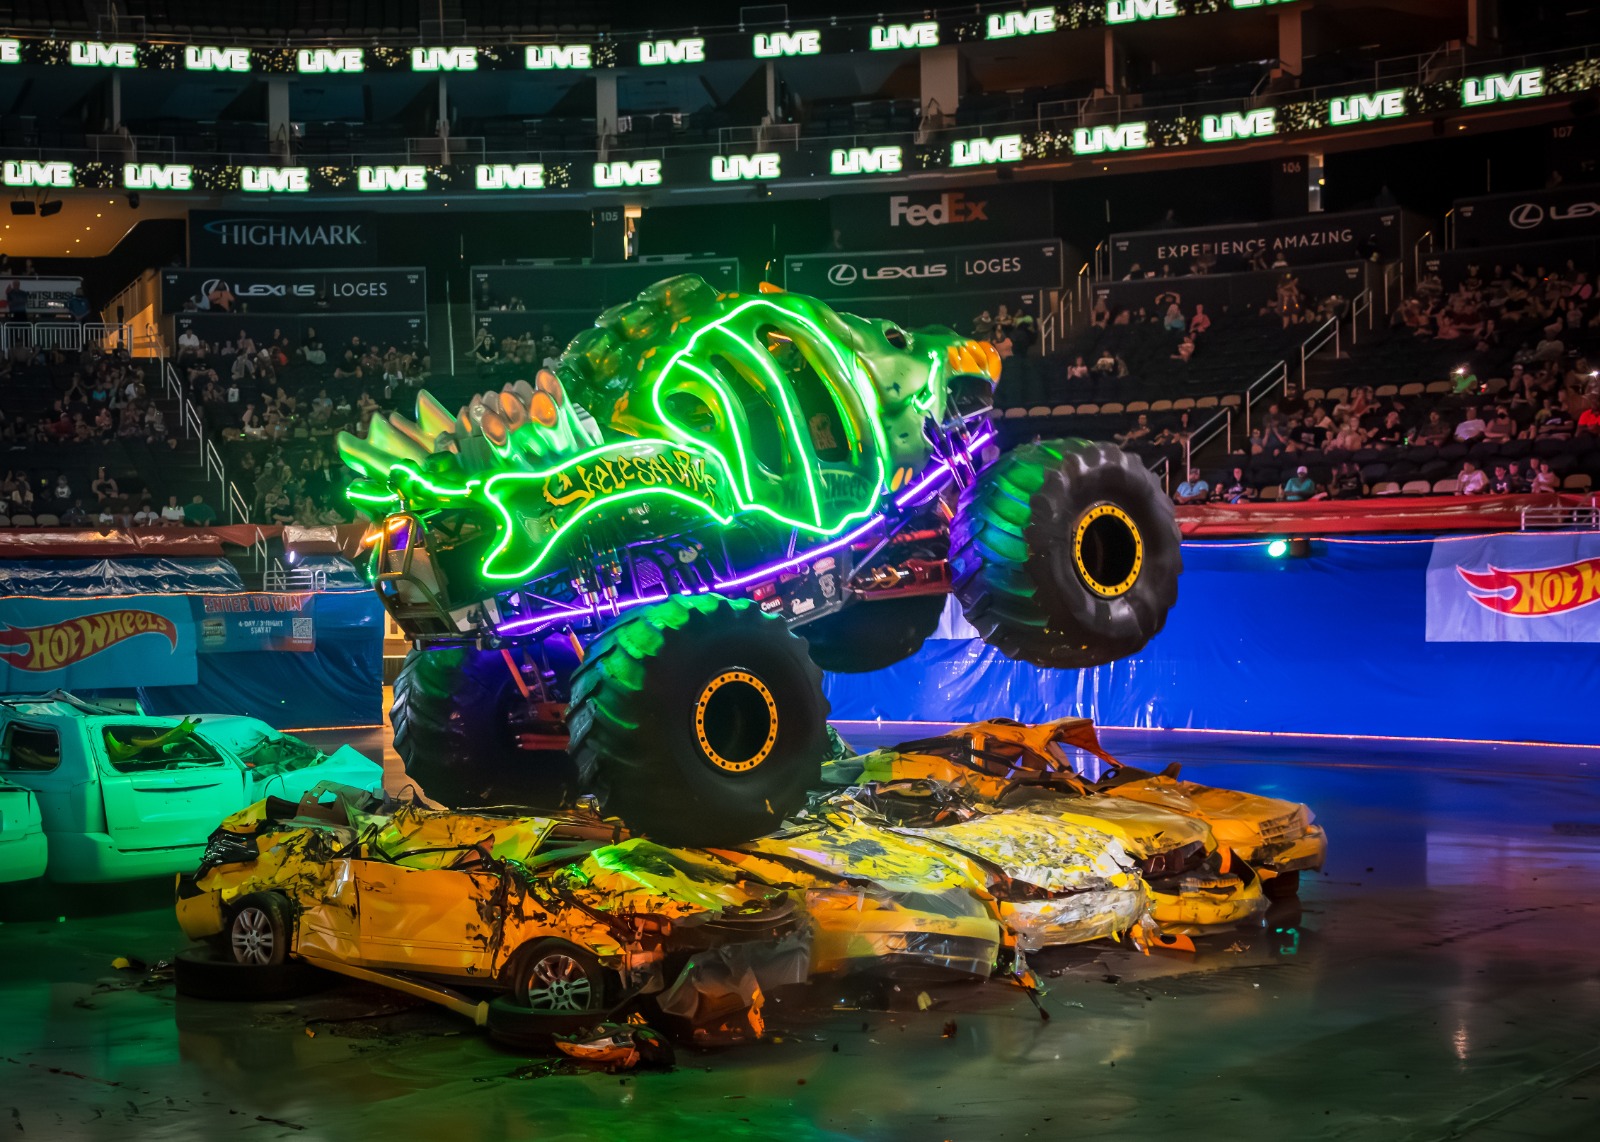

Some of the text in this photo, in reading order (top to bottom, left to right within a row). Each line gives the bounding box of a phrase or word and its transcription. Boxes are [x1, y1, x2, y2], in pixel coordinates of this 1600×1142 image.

[988, 8, 1056, 38] LIVE
[1108, 0, 1177, 22] LIVE
[754, 31, 820, 57] LIVE
[871, 22, 938, 49] LIVE
[71, 42, 136, 66] LIVE
[186, 46, 250, 71] LIVE
[298, 48, 363, 72] LIVE
[412, 47, 476, 70] LIVE
[526, 45, 591, 69] LIVE
[639, 38, 704, 64] LIVE
[1465, 71, 1542, 103] LIVE
[1331, 91, 1404, 123] LIVE
[1074, 123, 1146, 153] LIVE
[1203, 110, 1275, 141] LIVE
[1553, 126, 1574, 138] 107
[832, 147, 901, 174] LIVE
[953, 135, 1023, 166] LIVE
[4, 161, 72, 186] LIVE
[124, 164, 192, 189] LIVE
[242, 167, 308, 191] LIVE
[359, 166, 425, 190] LIVE
[476, 164, 542, 189] LIVE
[594, 160, 661, 187] LIVE
[712, 153, 780, 181] LIVE
[1282, 162, 1301, 173] 106
[600, 211, 618, 222] 105
[889, 192, 988, 226] FedEx
[221, 224, 361, 246] HIGHMARK
[1273, 229, 1353, 250] AMAZING
[862, 257, 1021, 280] LEXUS LOGES
[333, 282, 388, 297] LOGES
[203, 595, 302, 613] ENTER TO WIN
